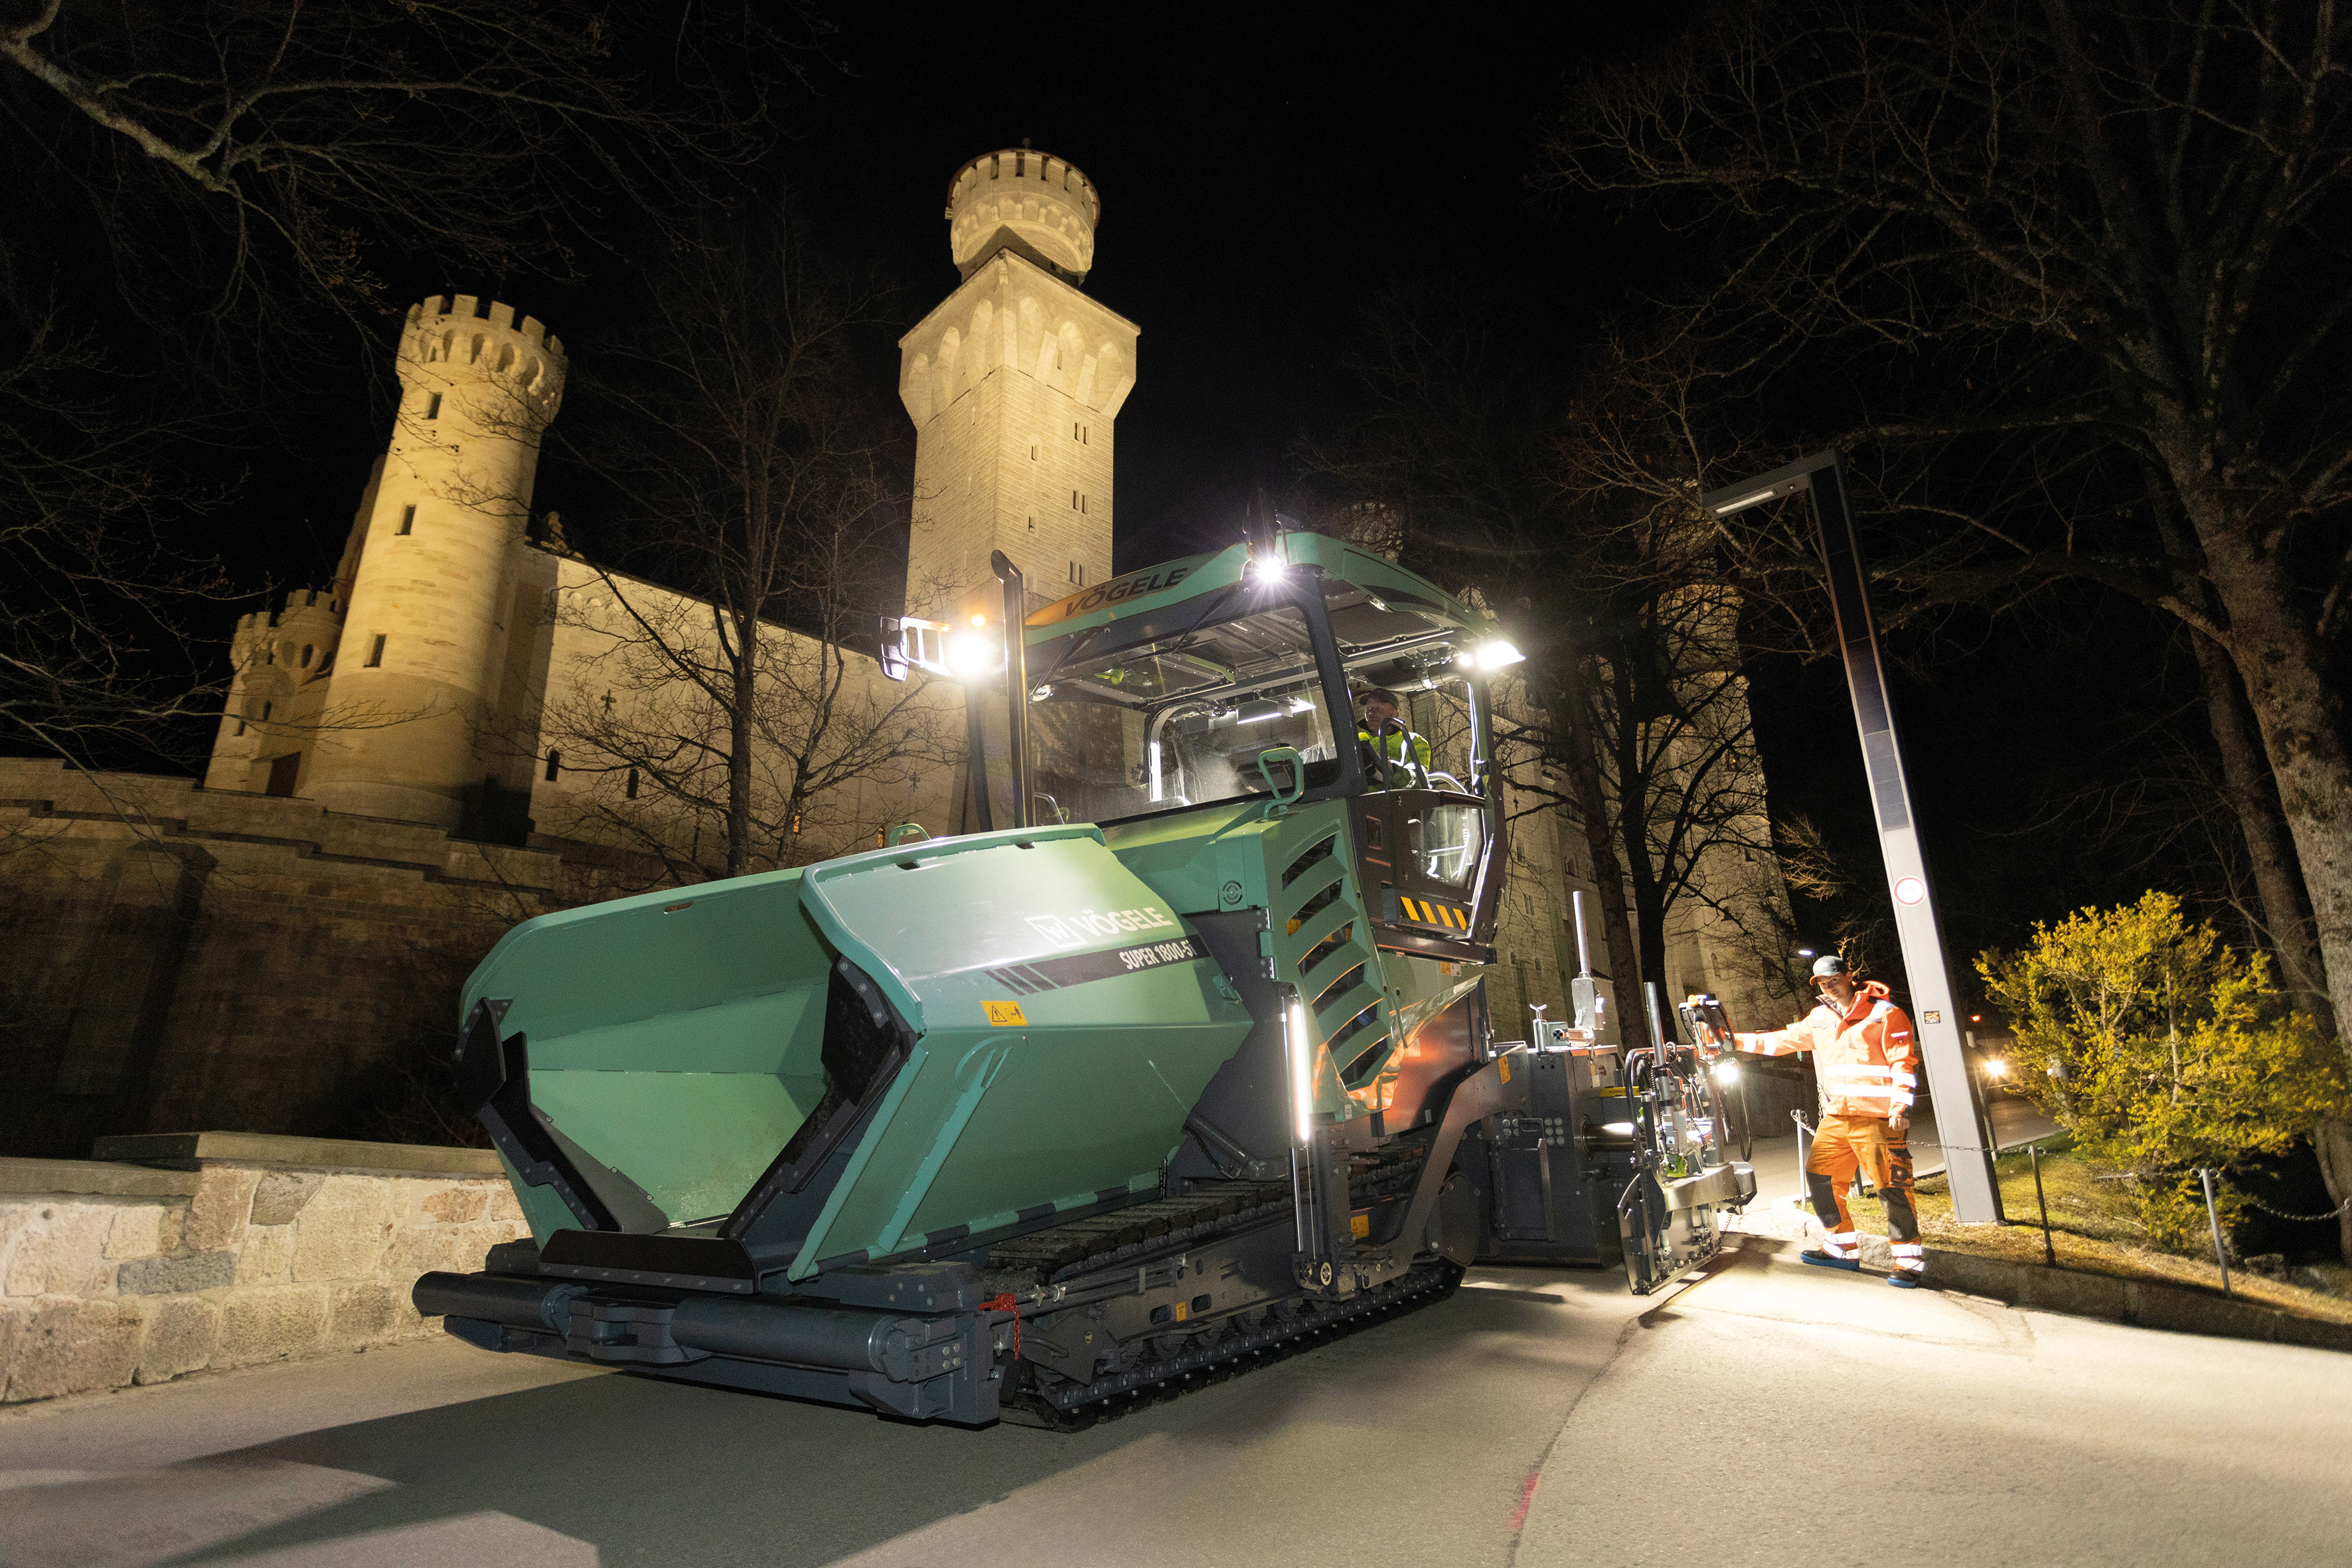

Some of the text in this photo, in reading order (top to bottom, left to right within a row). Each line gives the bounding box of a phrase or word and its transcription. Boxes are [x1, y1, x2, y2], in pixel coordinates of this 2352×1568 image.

[1065, 567, 1188, 617] VÖGELE
[1069, 907, 1174, 937] VÖGELE
[1119, 947, 1160, 970] SUPER
